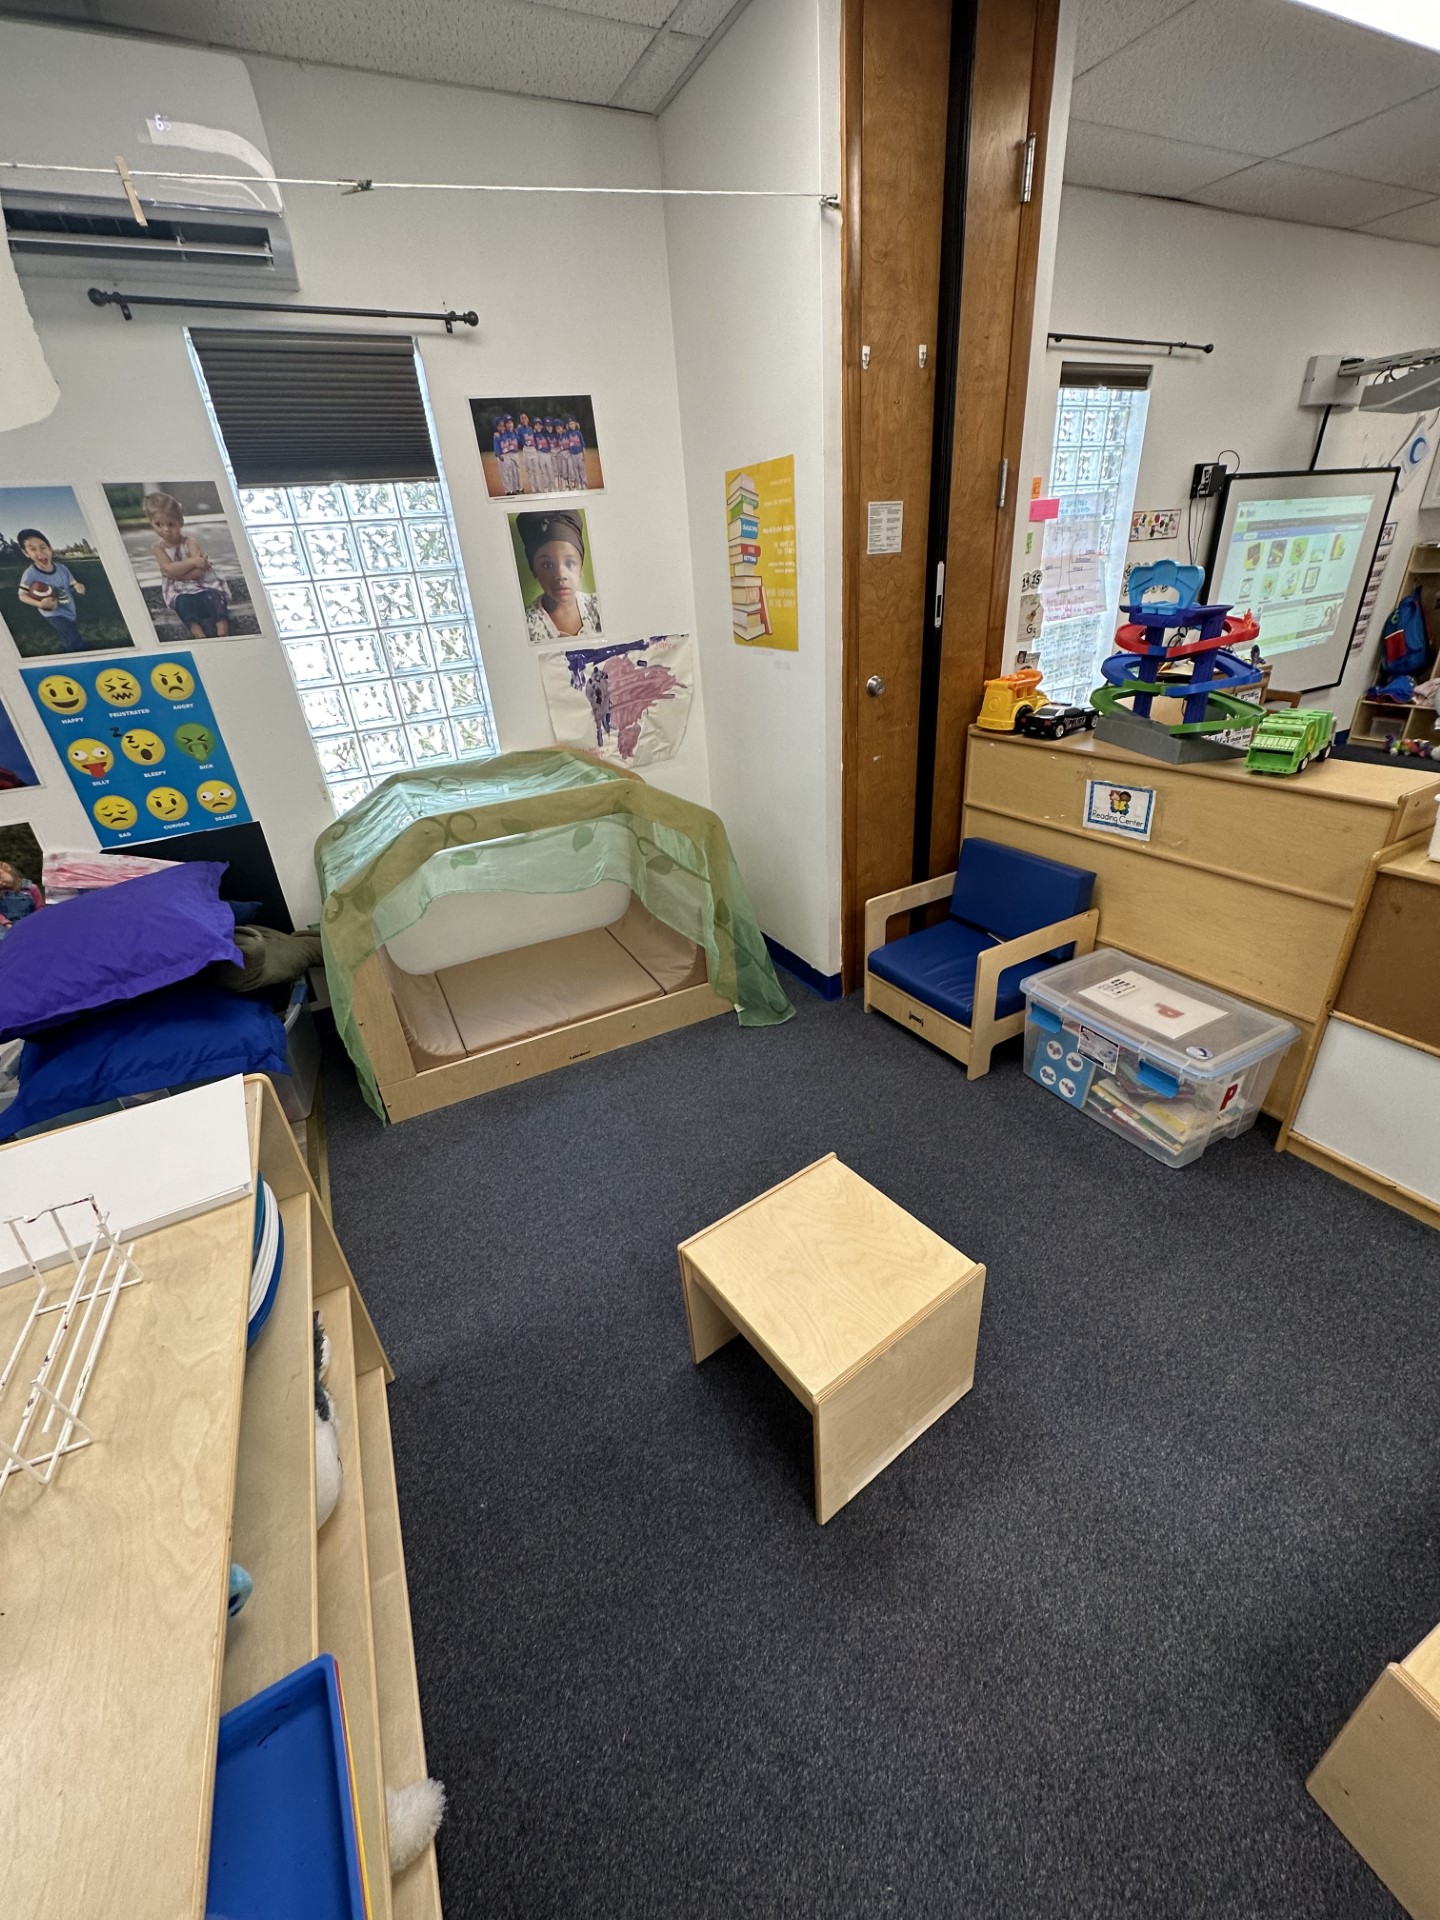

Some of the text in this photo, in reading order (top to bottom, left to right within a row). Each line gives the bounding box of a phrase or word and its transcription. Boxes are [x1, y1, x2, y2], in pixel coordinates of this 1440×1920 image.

[109, 708, 151, 718] FRUSTRATED
[61, 717, 84, 725] HAPPY
[143, 770, 167, 778] SLEEPY
[91, 779, 110, 787] SILLY
[214, 813, 238, 822] SCARED
[1092, 809, 1144, 828] Reading Center
[163, 821, 191, 830] CURIOUS
